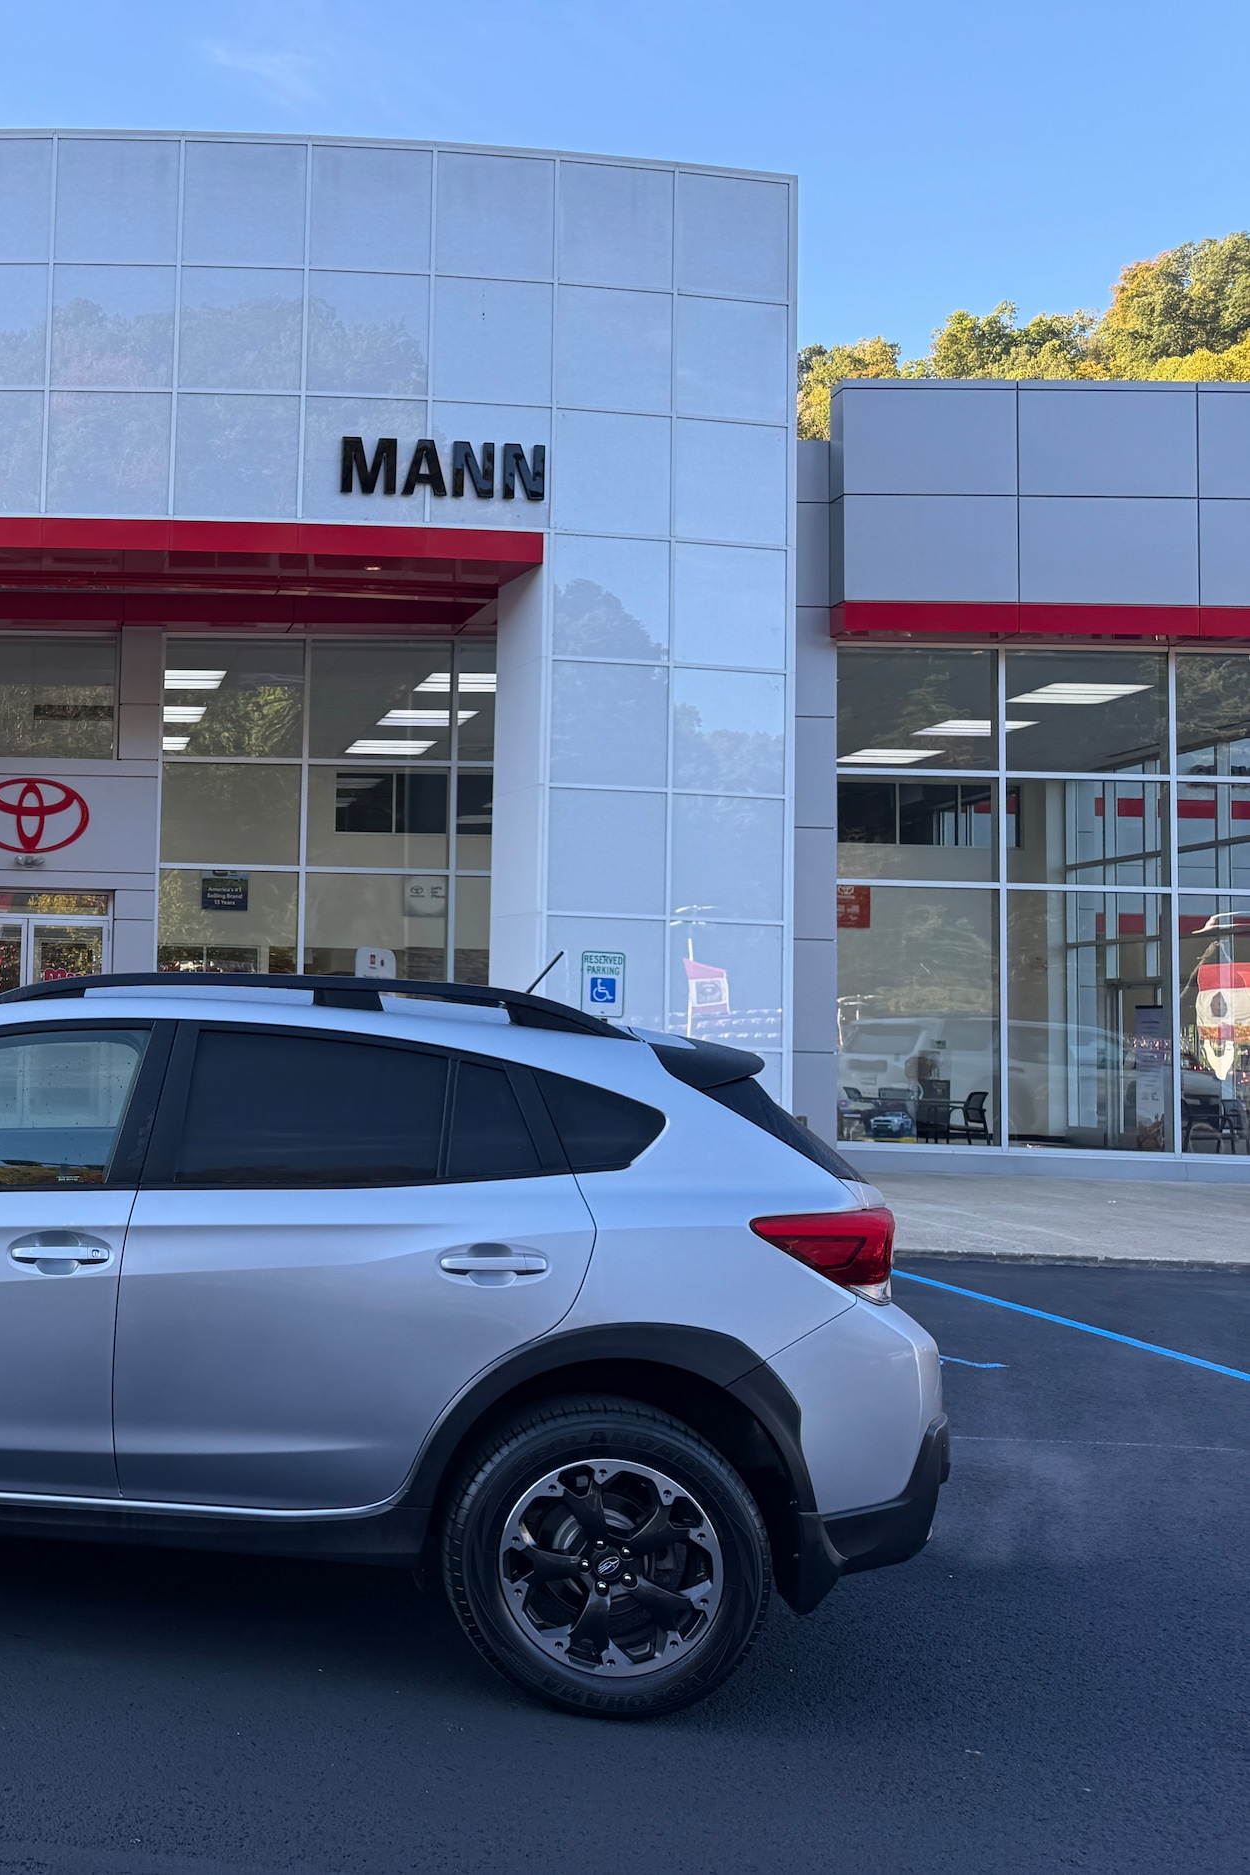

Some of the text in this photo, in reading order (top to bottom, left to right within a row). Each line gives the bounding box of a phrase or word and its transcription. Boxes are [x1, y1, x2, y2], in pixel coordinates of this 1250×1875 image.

[340, 436, 546, 501] MANN
[584, 955, 623, 965] RESERVED
[587, 965, 620, 976] PARKING
[541, 1673, 705, 1712] YOKOHAMA
